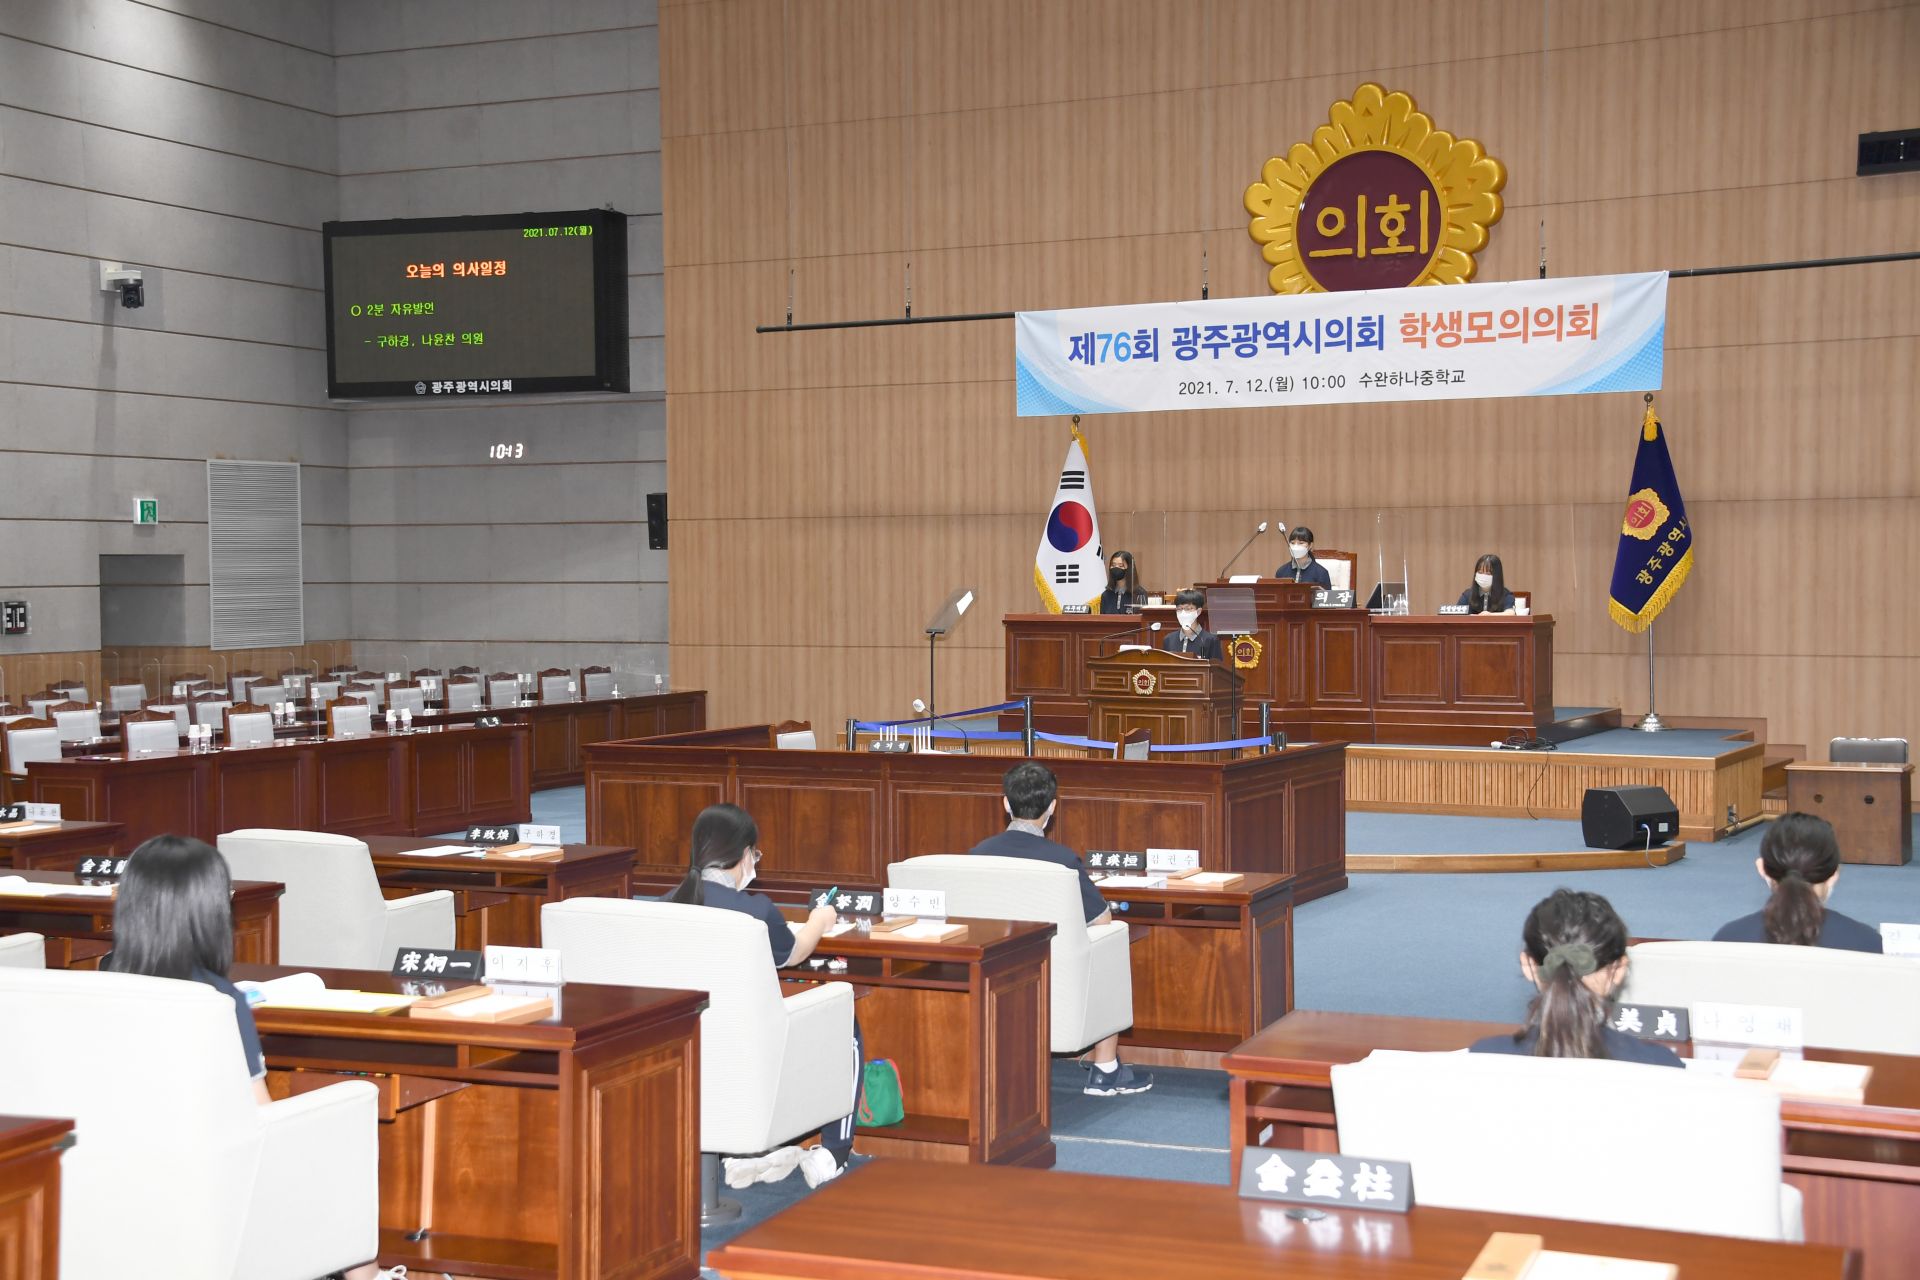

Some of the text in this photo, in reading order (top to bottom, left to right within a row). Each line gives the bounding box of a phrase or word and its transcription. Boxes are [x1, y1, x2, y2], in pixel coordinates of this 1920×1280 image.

[522, 225, 594, 238] 2021.07.12(월)
[1308, 190, 1430, 260] 의회
[405, 260, 508, 279] 오늘의 의사일정
[366, 302, 435, 317] 2분 자유발언
[421, 333, 456, 346] 나윤찬
[461, 331, 484, 345] 의원
[1068, 302, 1600, 366] 제76회 광주광역시의회 학생모의의회
[431, 379, 513, 394] 광주광역시의회
[1178, 368, 1466, 395] 2021. 7. 12.(월) 10:00 수완하나중학교
[490, 443, 524, 459] 10:13
[1631, 501, 1653, 527] 의회
